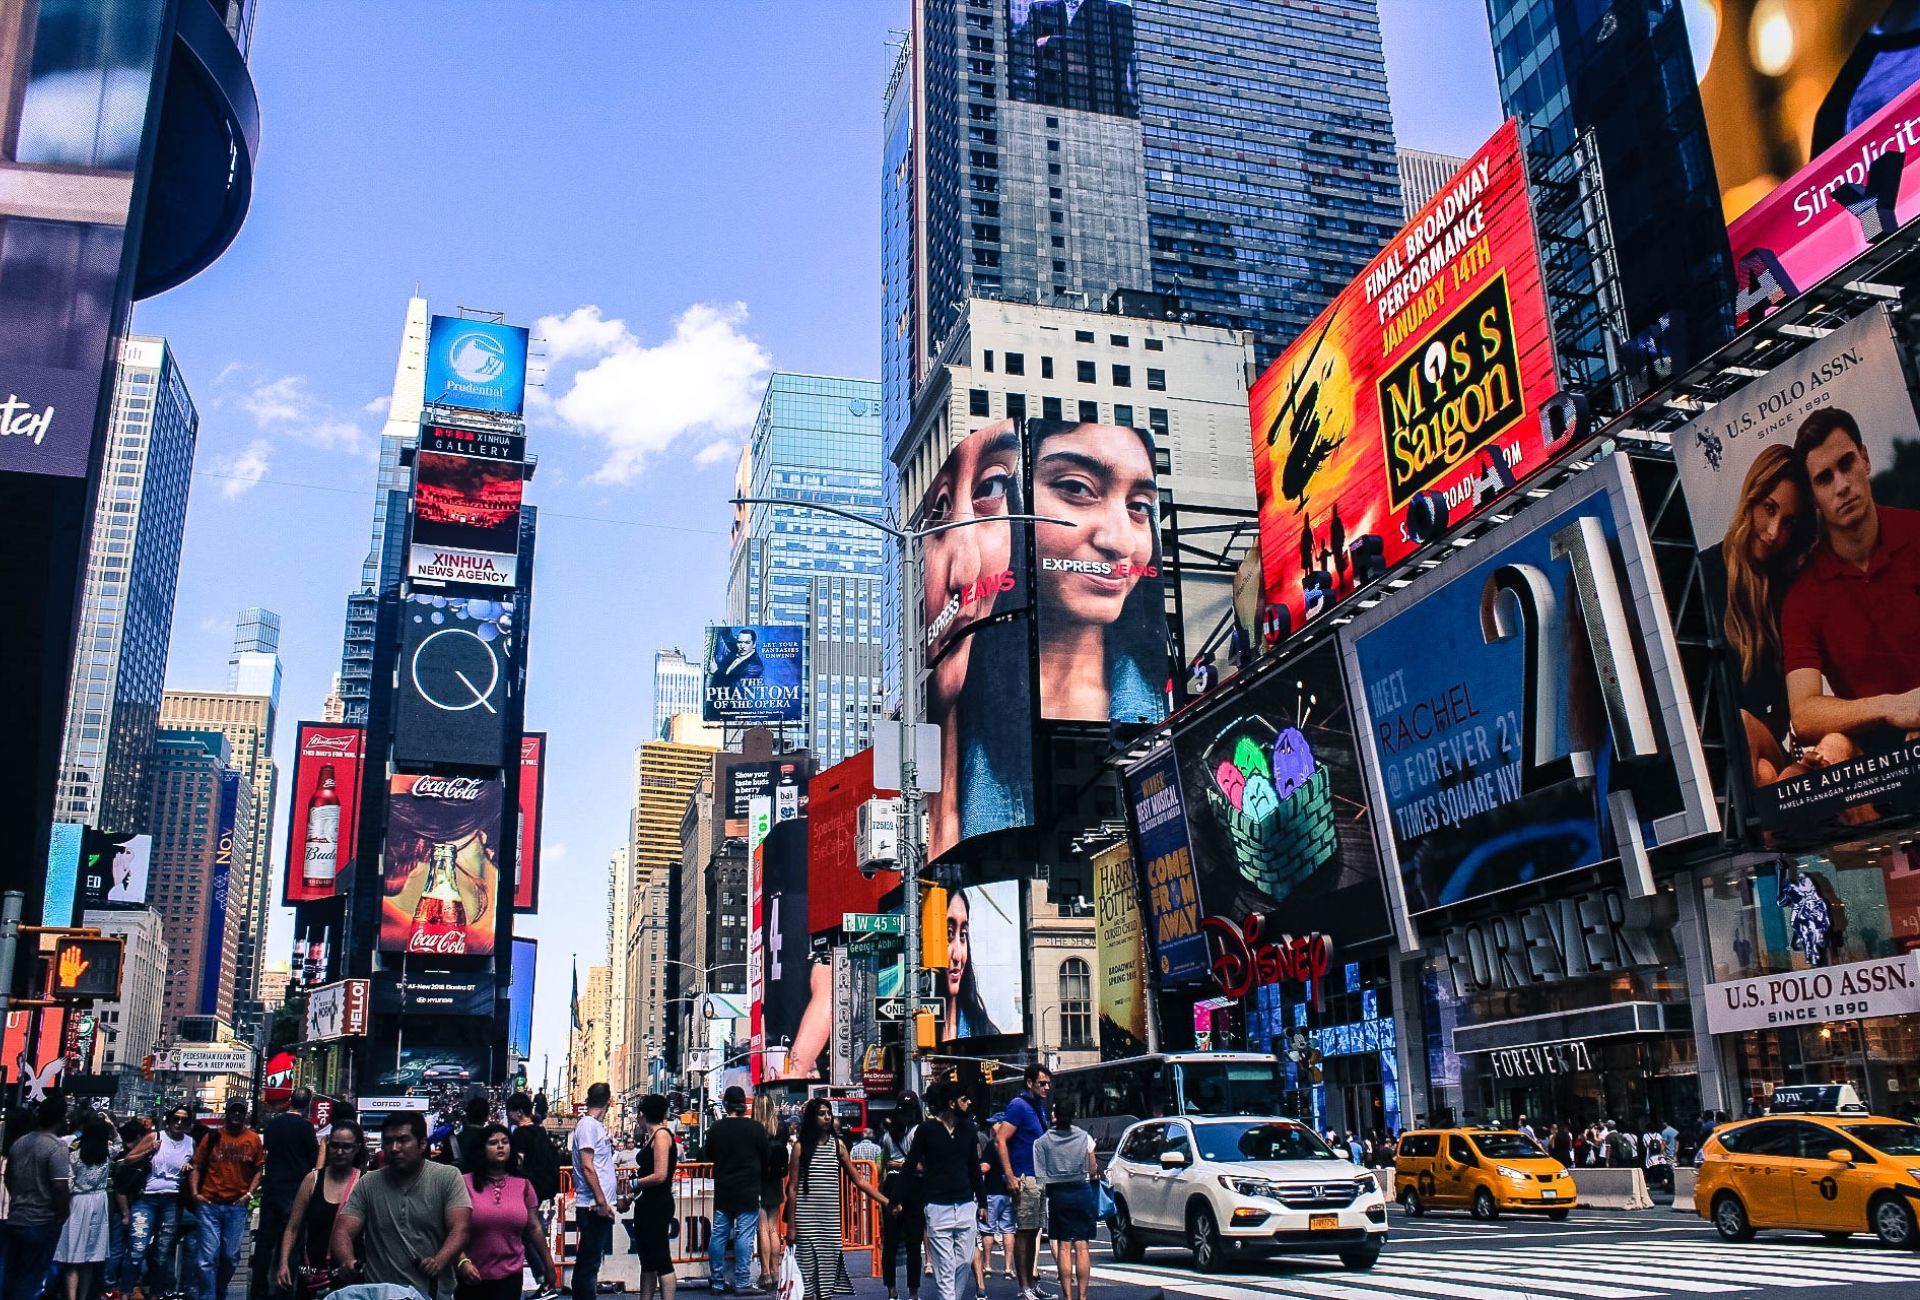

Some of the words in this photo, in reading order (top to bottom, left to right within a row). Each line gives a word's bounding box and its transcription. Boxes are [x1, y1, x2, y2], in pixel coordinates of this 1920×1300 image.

[1365, 248, 1405, 305] FINAL
[1405, 156, 1490, 263] BROADWAY
[1378, 201, 1486, 326] PERFORMANCE
[1382, 275, 1445, 359] JANUARY
[1451, 235, 1492, 291] 14TH
[447, 380, 503, 397] Prudential
[1725, 412, 1757, 439] U.S.
[1758, 380, 1806, 421] POLO
[1809, 347, 1864, 391] ASSN.
[1394, 363, 1514, 487] Saigon
[1757, 413, 1794, 440] SINCE
[1799, 392, 1831, 415] 1890
[435, 440, 509, 457] GALLERY
[477, 434, 510, 446] XINHUA
[418, 565, 454, 578] NEWS
[457, 569, 508, 582] AGENCY
[433, 553, 495, 571] XINHUA
[1042, 558, 1111, 575] EXPRESS
[1111, 564, 1159, 578] JEANS
[927, 593, 960, 647] EXPRESS
[959, 570, 1016, 609] JEANS
[705, 685, 800, 702] PHANTOM
[741, 678, 763, 687] THE
[1371, 669, 1408, 718] MEET
[714, 700, 728, 709] OF
[731, 700, 753, 709] THE
[755, 699, 791, 709] OPERA
[1379, 682, 1481, 757] RACHEL
[1388, 764, 1402, 799] @
[1405, 726, 1491, 790] FOREVER
[1497, 711, 1521, 753] 21
[754, 772, 769, 780] your
[1778, 779, 1812, 799] LIVE
[1779, 799, 1804, 811] PAMELA
[1806, 787, 1844, 803] FLANAGAN
[1853, 777, 1879, 790] JONNY
[1881, 767, 1909, 781] LAVINE
[740, 787, 760, 795] berry
[780, 790, 793, 800] bai
[1136, 797, 1152, 823] BEST
[1150, 784, 1179, 817] MUSICAL
[1396, 795, 1439, 840] TIMES
[1440, 772, 1498, 829] SQUARE
[1148, 848, 1191, 887] COME
[857, 916, 869, 930] W
[873, 916, 888, 931] 45
[1158, 902, 1198, 945] AWAY
[849, 942, 876, 953] George
[1441, 887, 1656, 997] FOREVER
[1108, 960, 1136, 976] BROADWAY
[1108, 974, 1126, 987] SPRING
[1724, 984, 1764, 1010] U.S.
[1768, 974, 1832, 1005] POLO
[1840, 963, 1915, 996] ASSN.
[350, 982, 365, 1032] HELLO!
[885, 1003, 904, 1015] ONE
[1768, 1006, 1817, 1023] SINCE
[1825, 1001, 1868, 1016] 1890
[1491, 1045, 1569, 1078] FOREVER
[1571, 1042, 1593, 1071] 21
